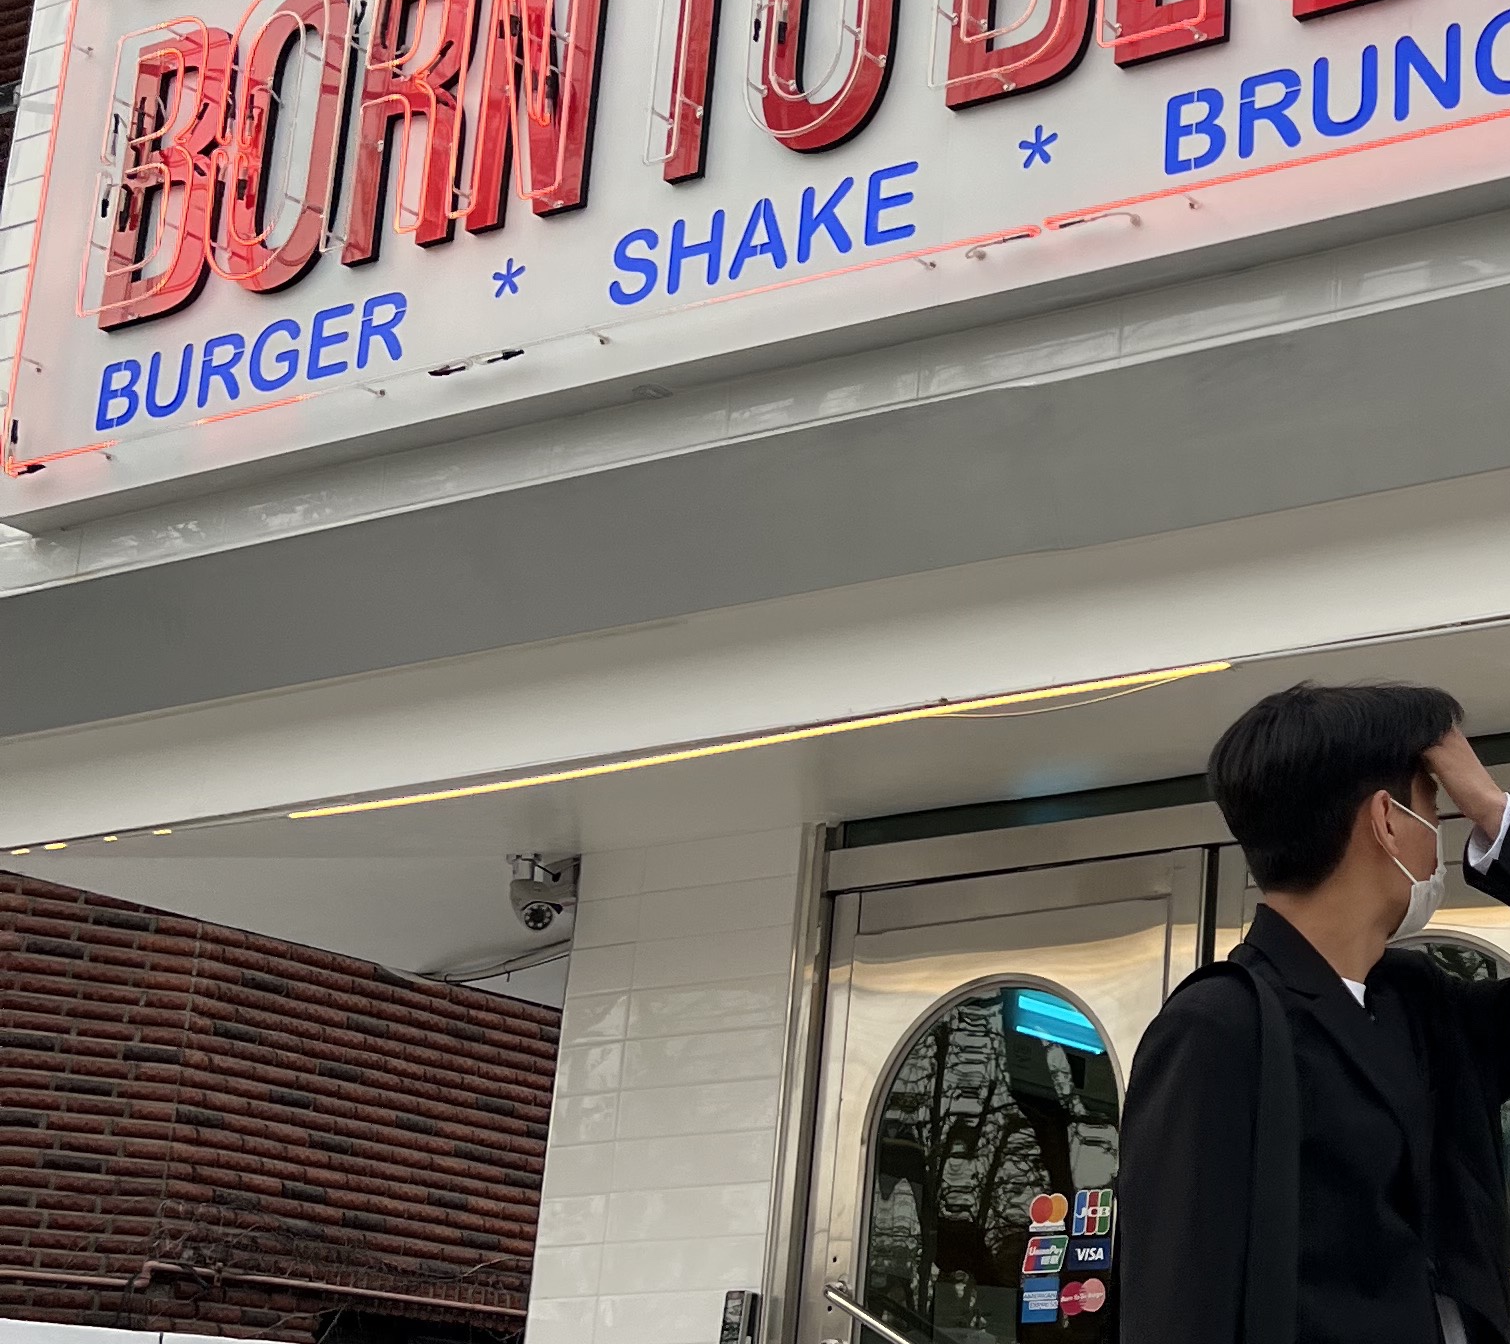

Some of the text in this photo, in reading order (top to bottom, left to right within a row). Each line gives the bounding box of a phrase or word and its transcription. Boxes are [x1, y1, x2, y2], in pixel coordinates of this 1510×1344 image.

[95, 292, 408, 432] BURGER
[608, 161, 919, 306] SHAKE
[1075, 1247, 1105, 1261] VISA
